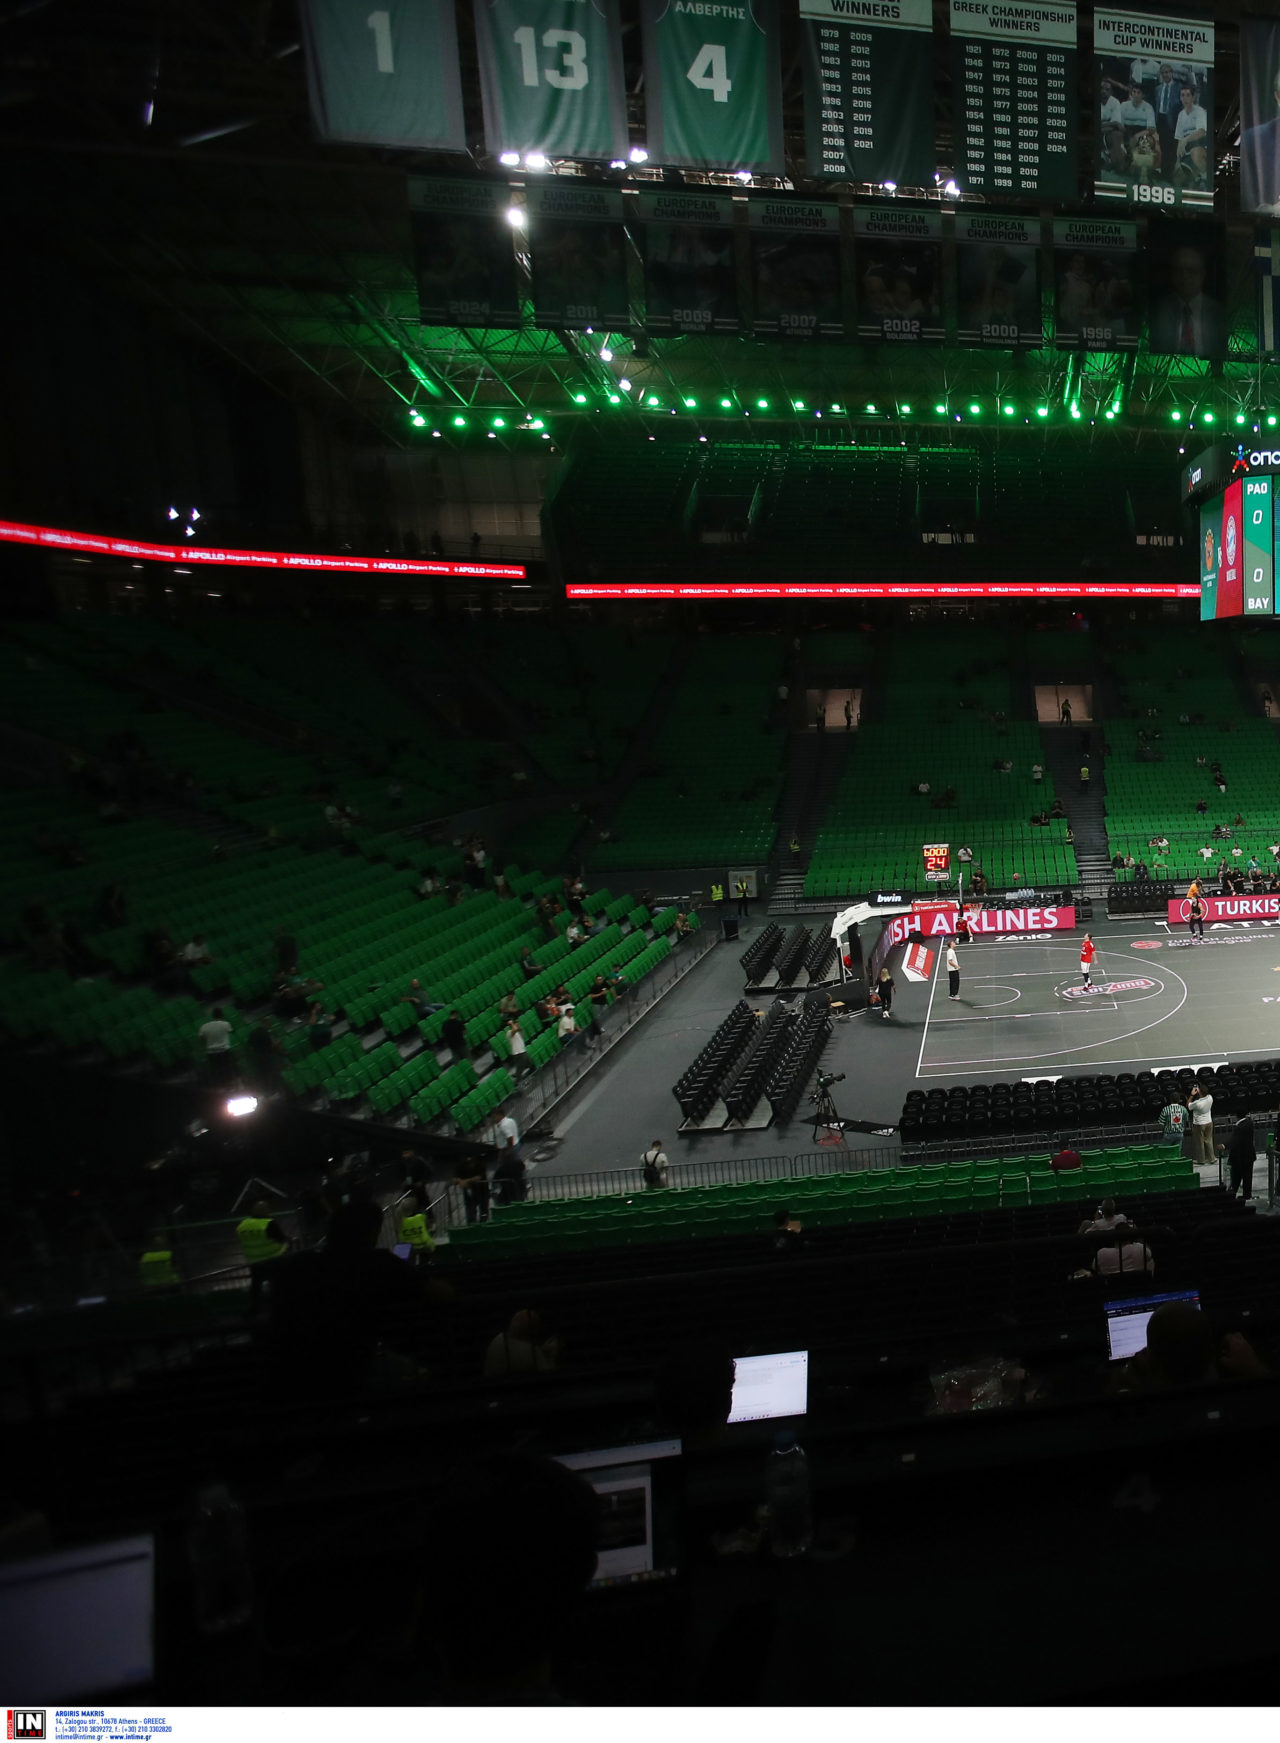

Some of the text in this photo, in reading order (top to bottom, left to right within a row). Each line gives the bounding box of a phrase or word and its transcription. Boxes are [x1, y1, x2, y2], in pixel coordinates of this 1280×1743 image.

[831, 0, 900, 18] WINNERS
[953, 1, 1075, 24] GREEK CHAMPIONSHIP
[988, 17, 1040, 32] WINNERS
[1098, 20, 1209, 44] INTERCONTINENTAL
[367, 10, 395, 74] 1
[1113, 34, 1194, 55] CUP WINNERS
[512, 26, 590, 90] 13
[686, 43, 732, 102] 4
[1132, 184, 1176, 204] 1996
[1247, 482, 1268, 495] PAO
[1248, 598, 1269, 609] BAY
[927, 858, 946, 869] 24
[877, 894, 902, 902] bwin
[1215, 898, 1280, 916] TURKIS
